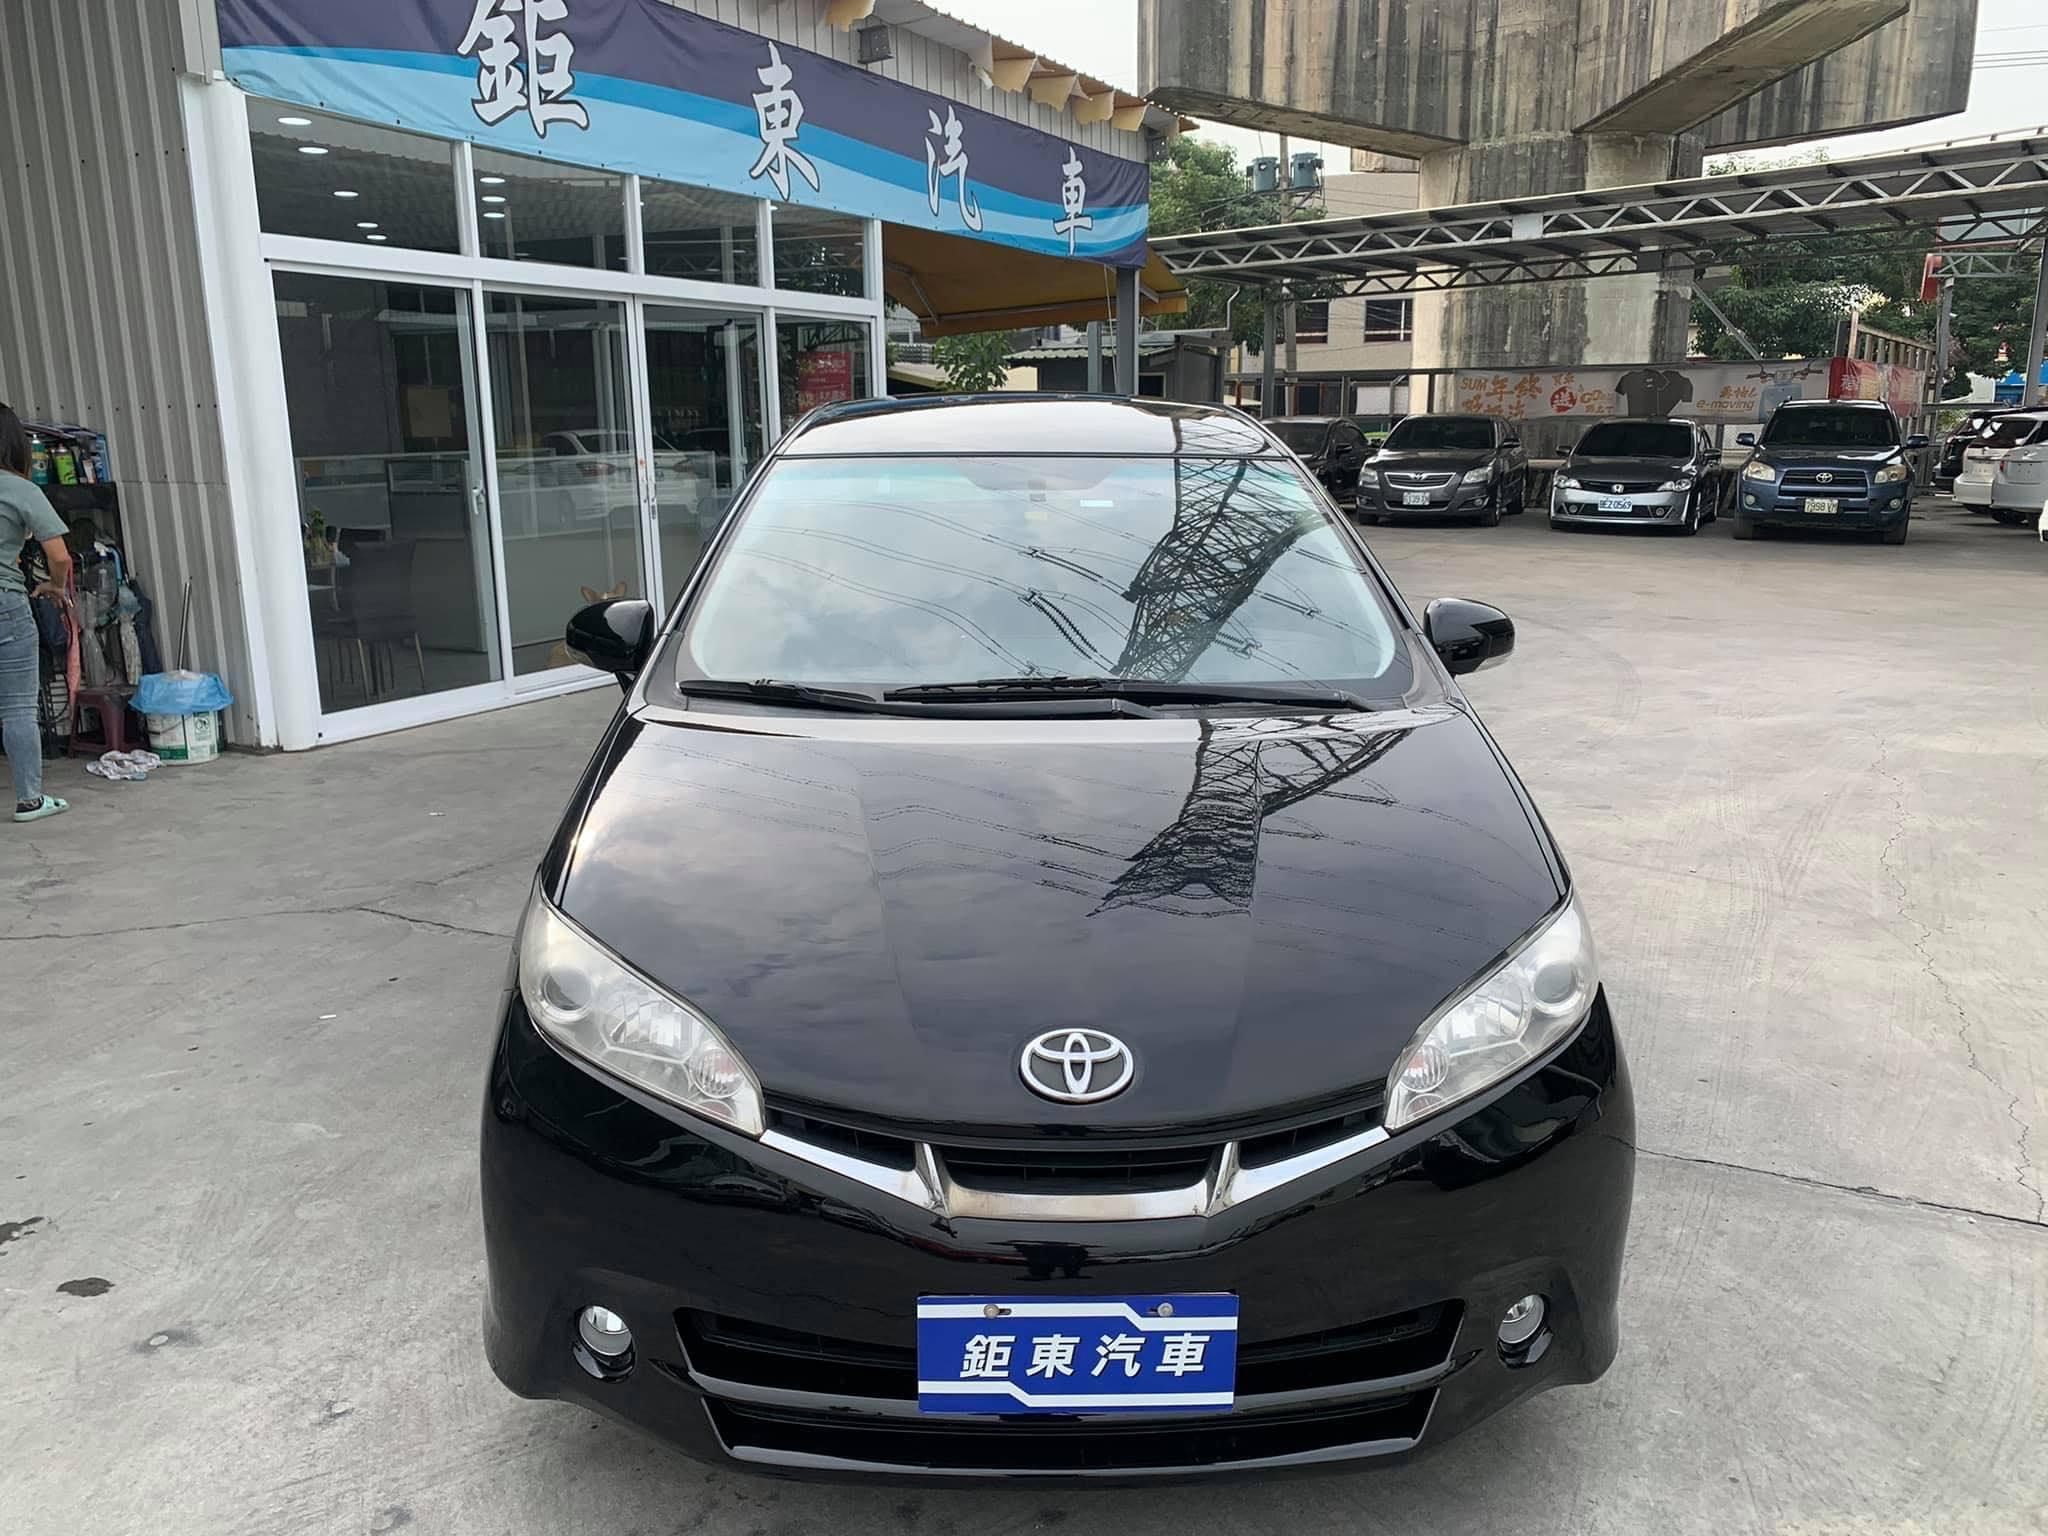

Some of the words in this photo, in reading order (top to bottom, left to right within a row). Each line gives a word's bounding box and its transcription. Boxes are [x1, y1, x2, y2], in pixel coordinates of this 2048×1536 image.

[457, 0, 1094, 256] 鉅東汽車
[1460, 377, 1488, 391] SUM
[1695, 399, 1755, 411] e-moving
[959, 1332, 1211, 1379] 鉅東汽車
